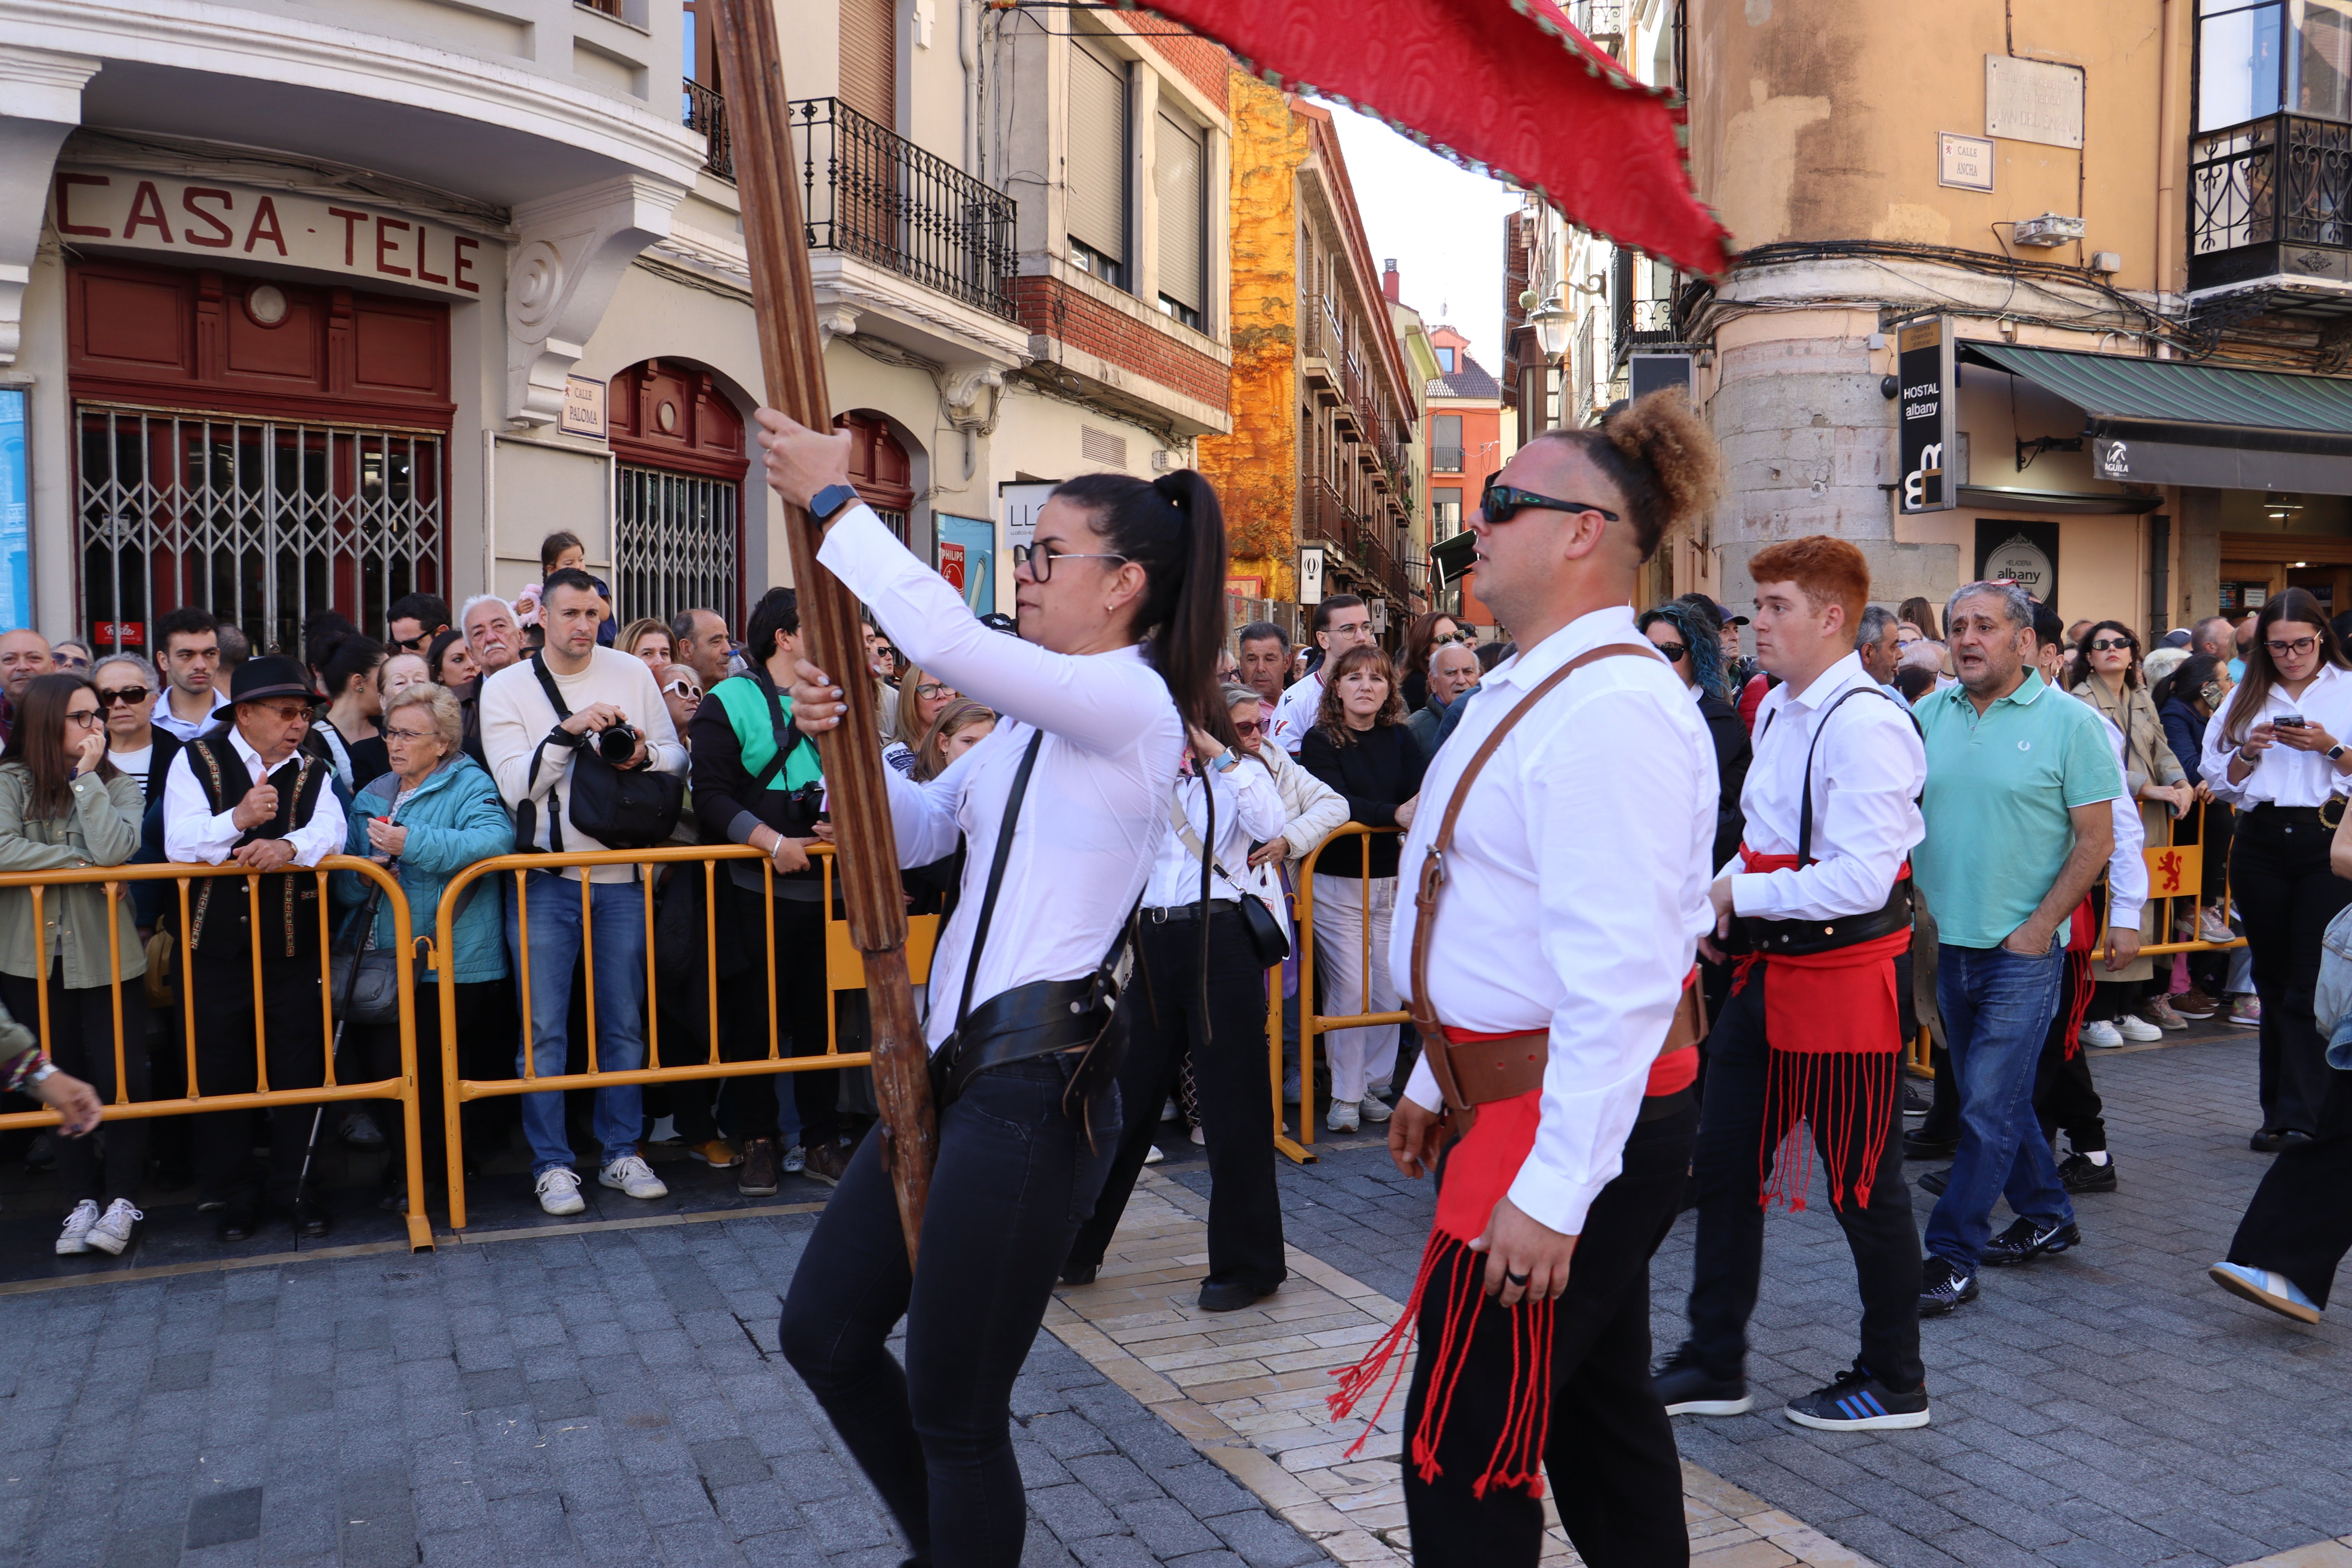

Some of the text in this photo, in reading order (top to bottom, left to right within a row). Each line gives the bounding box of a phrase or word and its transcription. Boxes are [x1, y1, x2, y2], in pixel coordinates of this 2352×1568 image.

[2022, 87, 2029, 101] la
[1991, 107, 2017, 124] JUAN
[2020, 111, 2039, 127] DEL
[1958, 146, 1977, 157] CALLE
[1957, 162, 1977, 176] ANCHA
[56, 172, 479, 293] CASA TELE
[1911, 332, 1933, 341] chambre
[1913, 339, 1932, 347] zimmer
[575, 388, 592, 401] CALLE
[1904, 383, 1939, 399] HOSTAL
[570, 406, 597, 425] PALOMA
[1906, 402, 1938, 419] albany
[1011, 504, 1046, 526] LL
[942, 549, 963, 562] PHILIPS
[1998, 568, 2041, 584] albany
